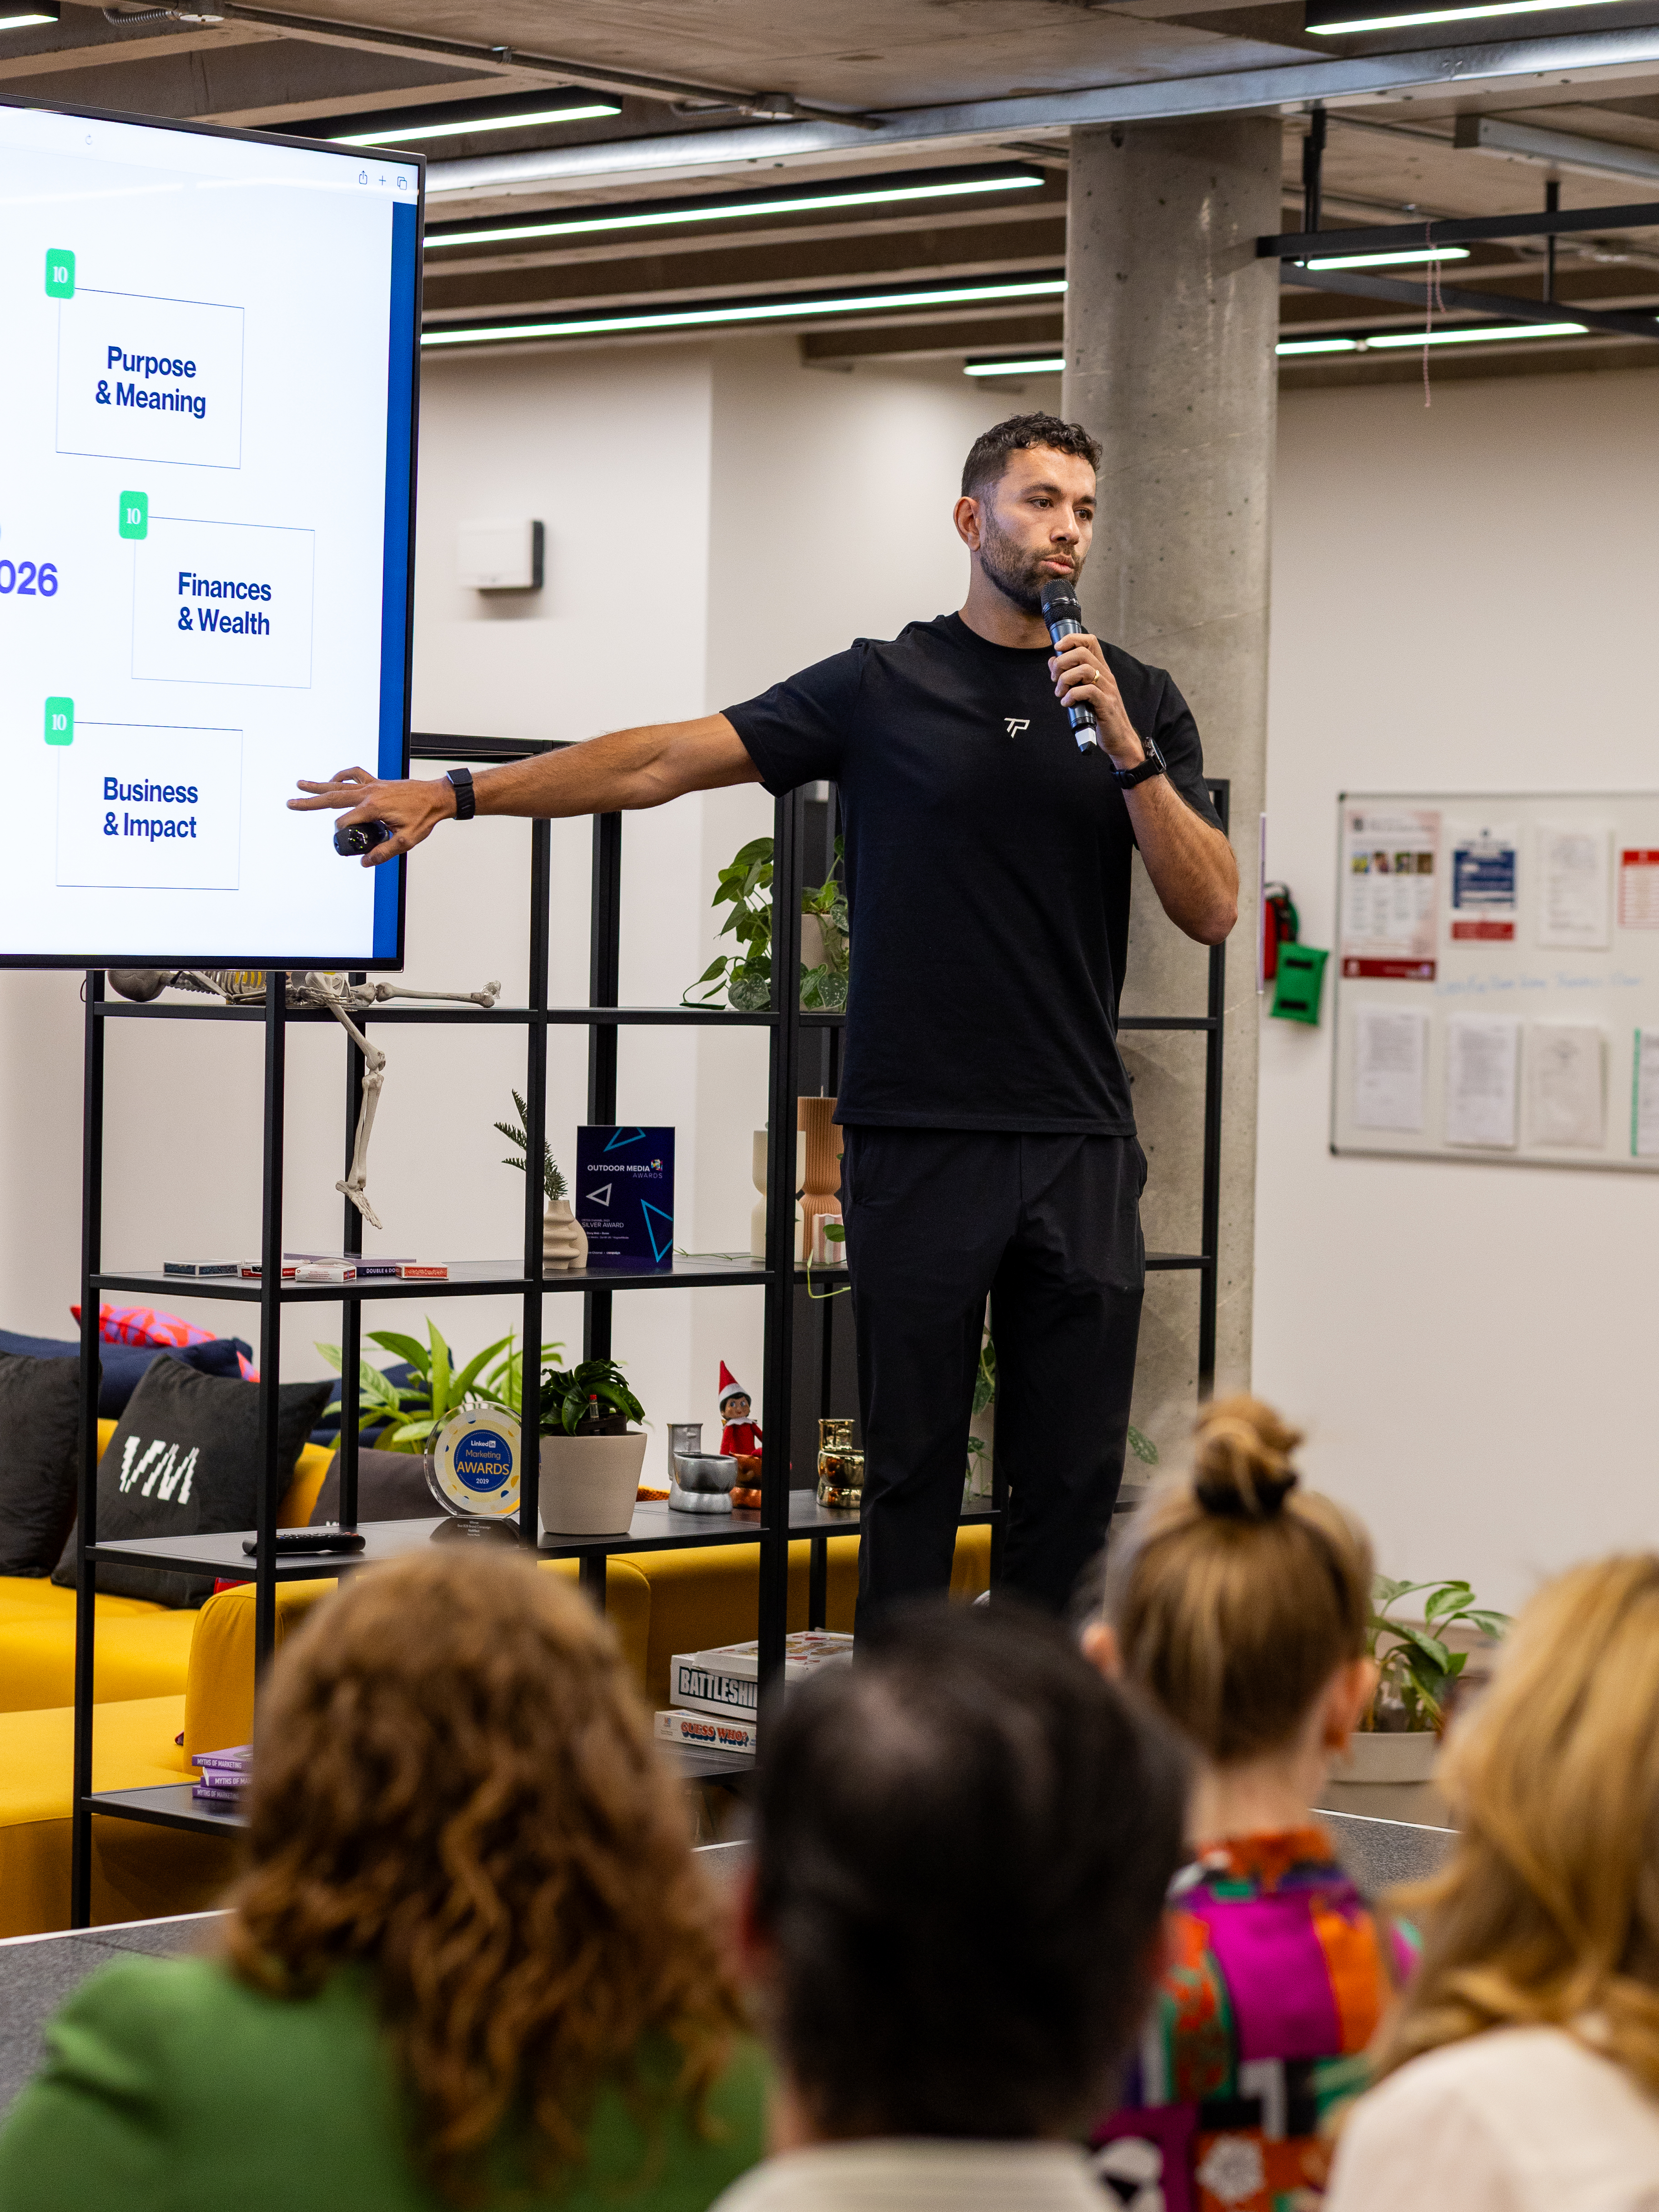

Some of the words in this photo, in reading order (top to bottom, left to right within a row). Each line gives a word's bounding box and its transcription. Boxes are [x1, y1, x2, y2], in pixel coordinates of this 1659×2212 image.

[52, 266, 69, 284] 10
[107, 346, 196, 379] Purpose
[96, 380, 112, 405] &
[116, 382, 206, 419] Meaning
[126, 508, 141, 525] 10
[0, 560, 58, 597] 026
[178, 571, 271, 601] Finances
[178, 606, 194, 631] &
[197, 608, 270, 635] Wealth
[51, 714, 67, 731] 10
[103, 777, 198, 804] Business
[103, 811, 119, 836] &
[124, 812, 196, 842] Impact
[465, 1449, 501, 1460] Marketing
[457, 1461, 510, 1475] AWARDS
[680, 1721, 715, 1739] GUESS
[717, 1727, 749, 1744] WHO?
[218, 1760, 242, 1769] MARKETING
